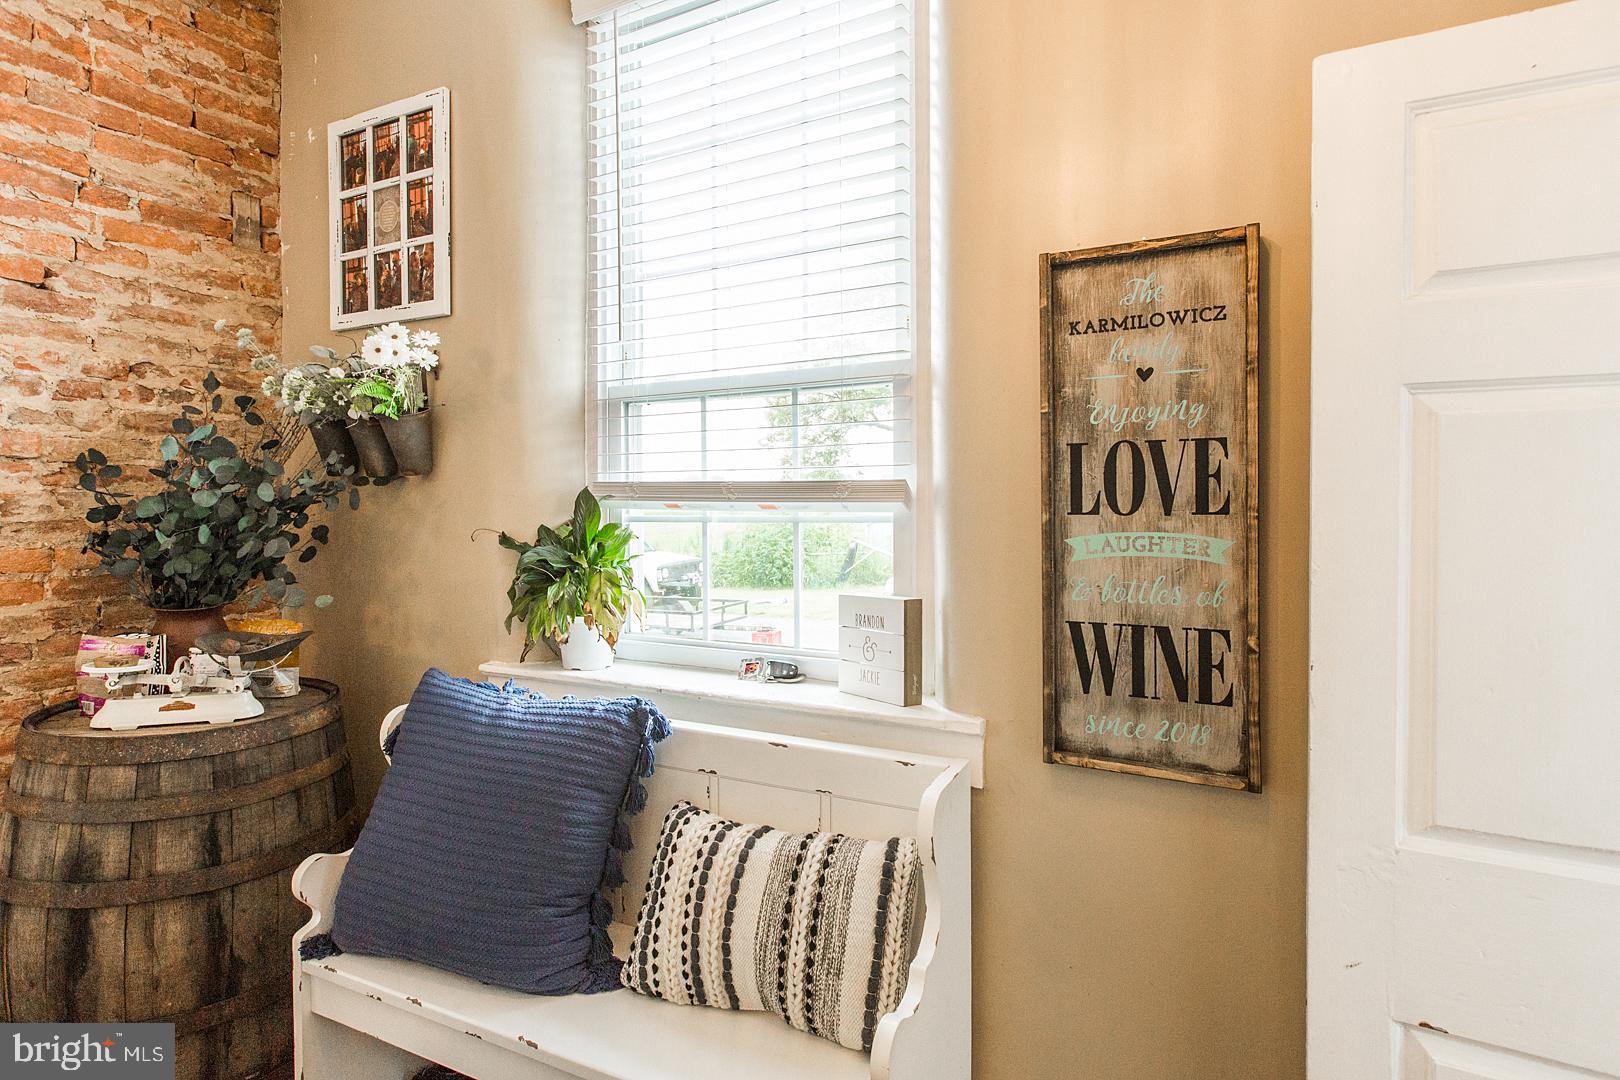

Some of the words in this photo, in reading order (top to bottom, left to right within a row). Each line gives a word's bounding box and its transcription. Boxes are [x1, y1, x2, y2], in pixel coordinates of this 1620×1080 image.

[1120, 272, 1168, 306] The
[1068, 305, 1227, 336] KARMILOWICZ
[1087, 399, 1210, 432] Enjoying
[1066, 437, 1231, 516] LOVE
[1083, 535, 1211, 558] LAUGHTER
[1099, 573, 1184, 607] bottles
[1196, 579, 1229, 608] of
[855, 613, 886, 630] BRANDON
[862, 635, 878, 662] &
[1065, 620, 1234, 708] WINE
[858, 669, 881, 687] JACKIE
[1085, 714, 1149, 740] since
[1154, 720, 1212, 745] 2018
